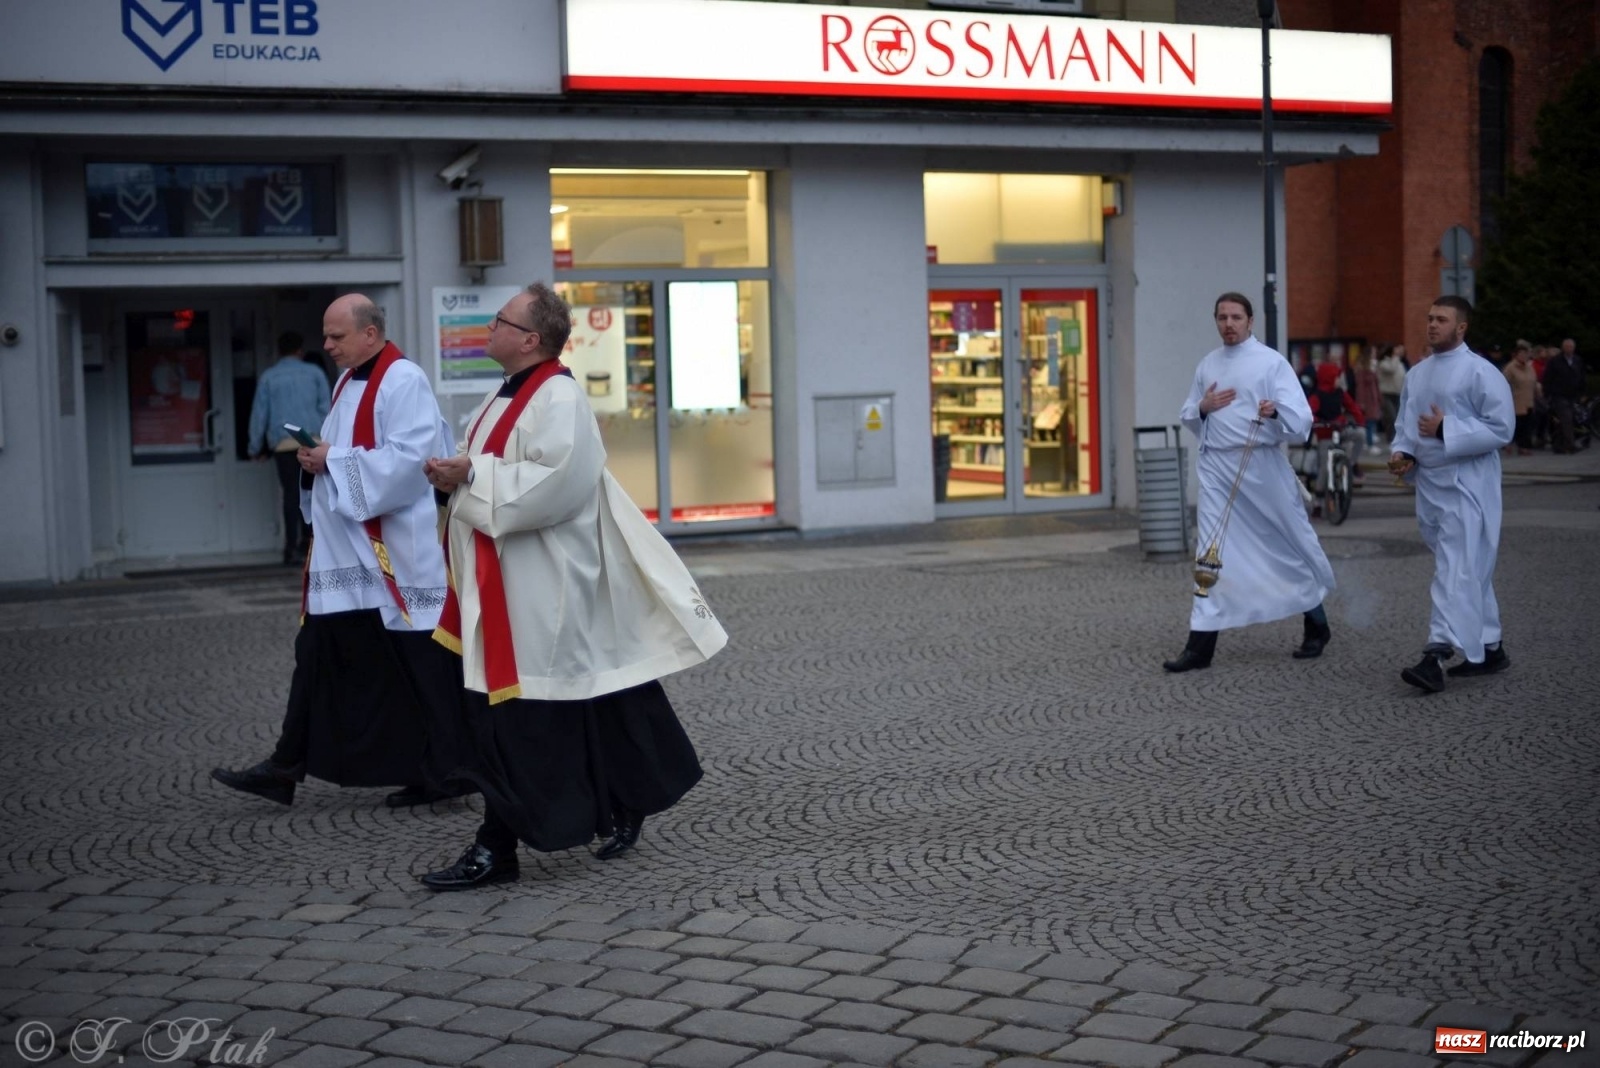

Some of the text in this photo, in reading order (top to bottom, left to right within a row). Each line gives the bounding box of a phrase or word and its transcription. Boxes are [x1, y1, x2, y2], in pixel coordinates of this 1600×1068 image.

[212, 0, 319, 36] TEB
[213, 44, 321, 62] EDUKACJA
[821, 14, 1197, 86] ROSSMANN
[193, 167, 227, 183] TEB
[267, 169, 302, 184] TEB
